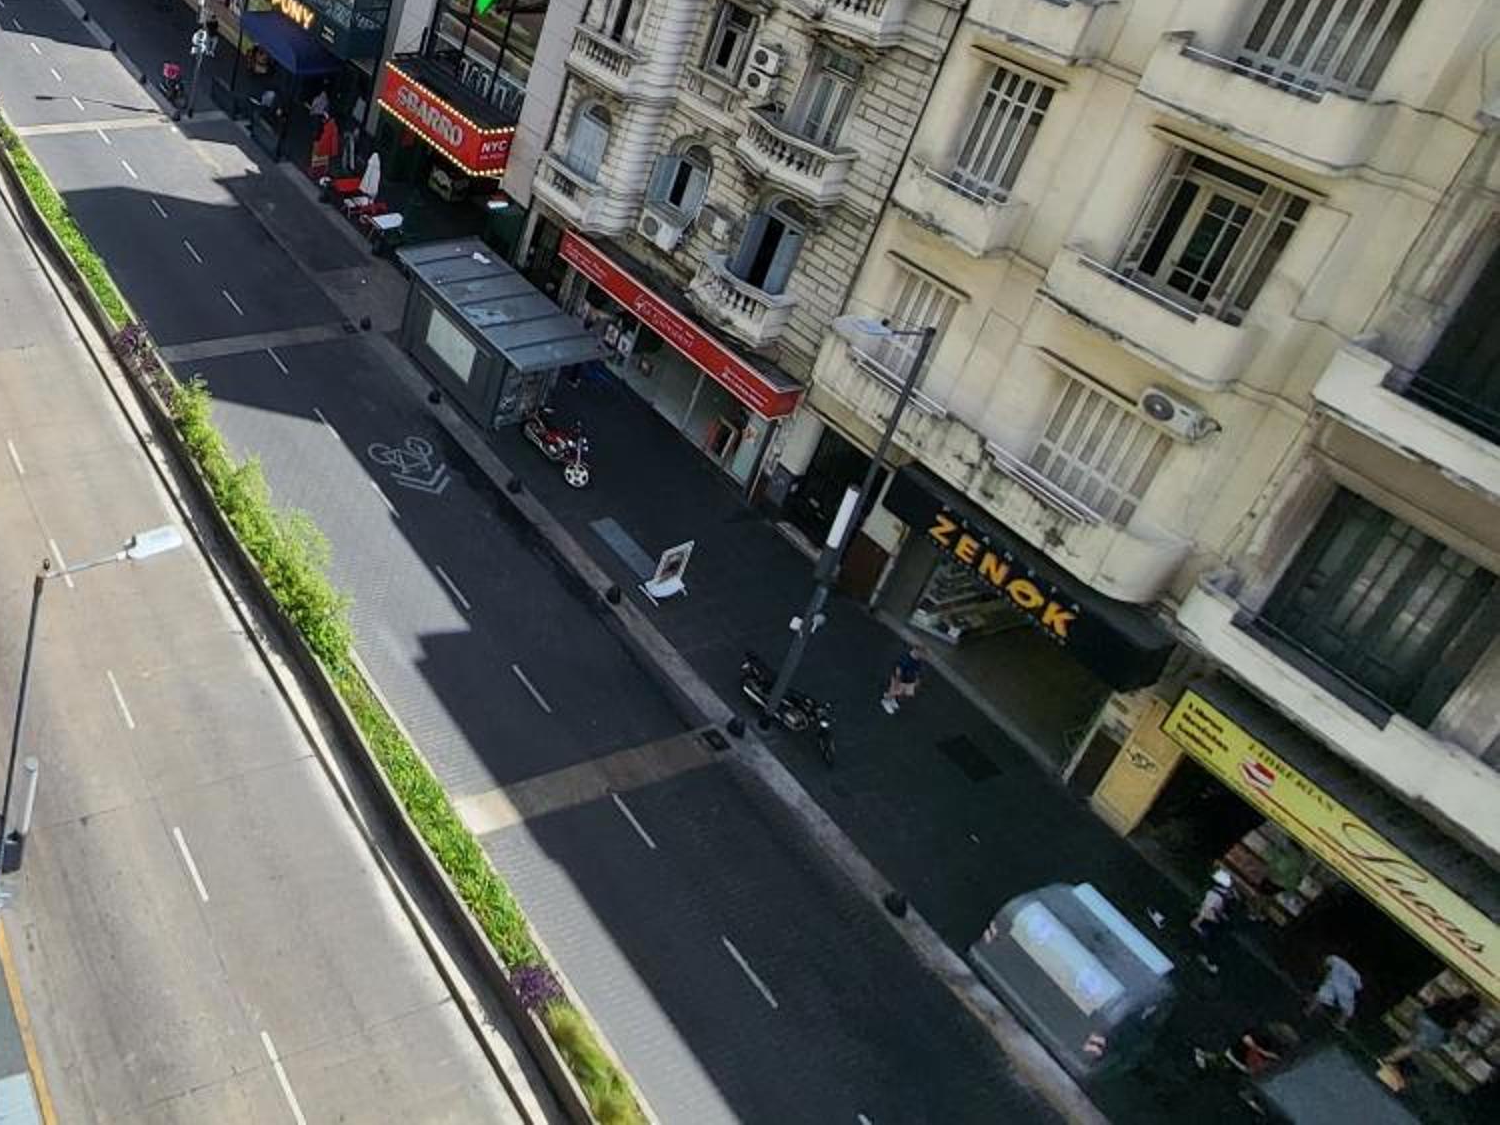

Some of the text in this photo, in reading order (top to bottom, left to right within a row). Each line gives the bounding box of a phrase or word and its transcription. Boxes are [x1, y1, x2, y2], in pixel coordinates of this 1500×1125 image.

[394, 85, 464, 148] SBARRO
[481, 139, 509, 154] NYC
[927, 513, 1079, 638] ZENOK
[1319, 819, 1486, 954] Lucas
